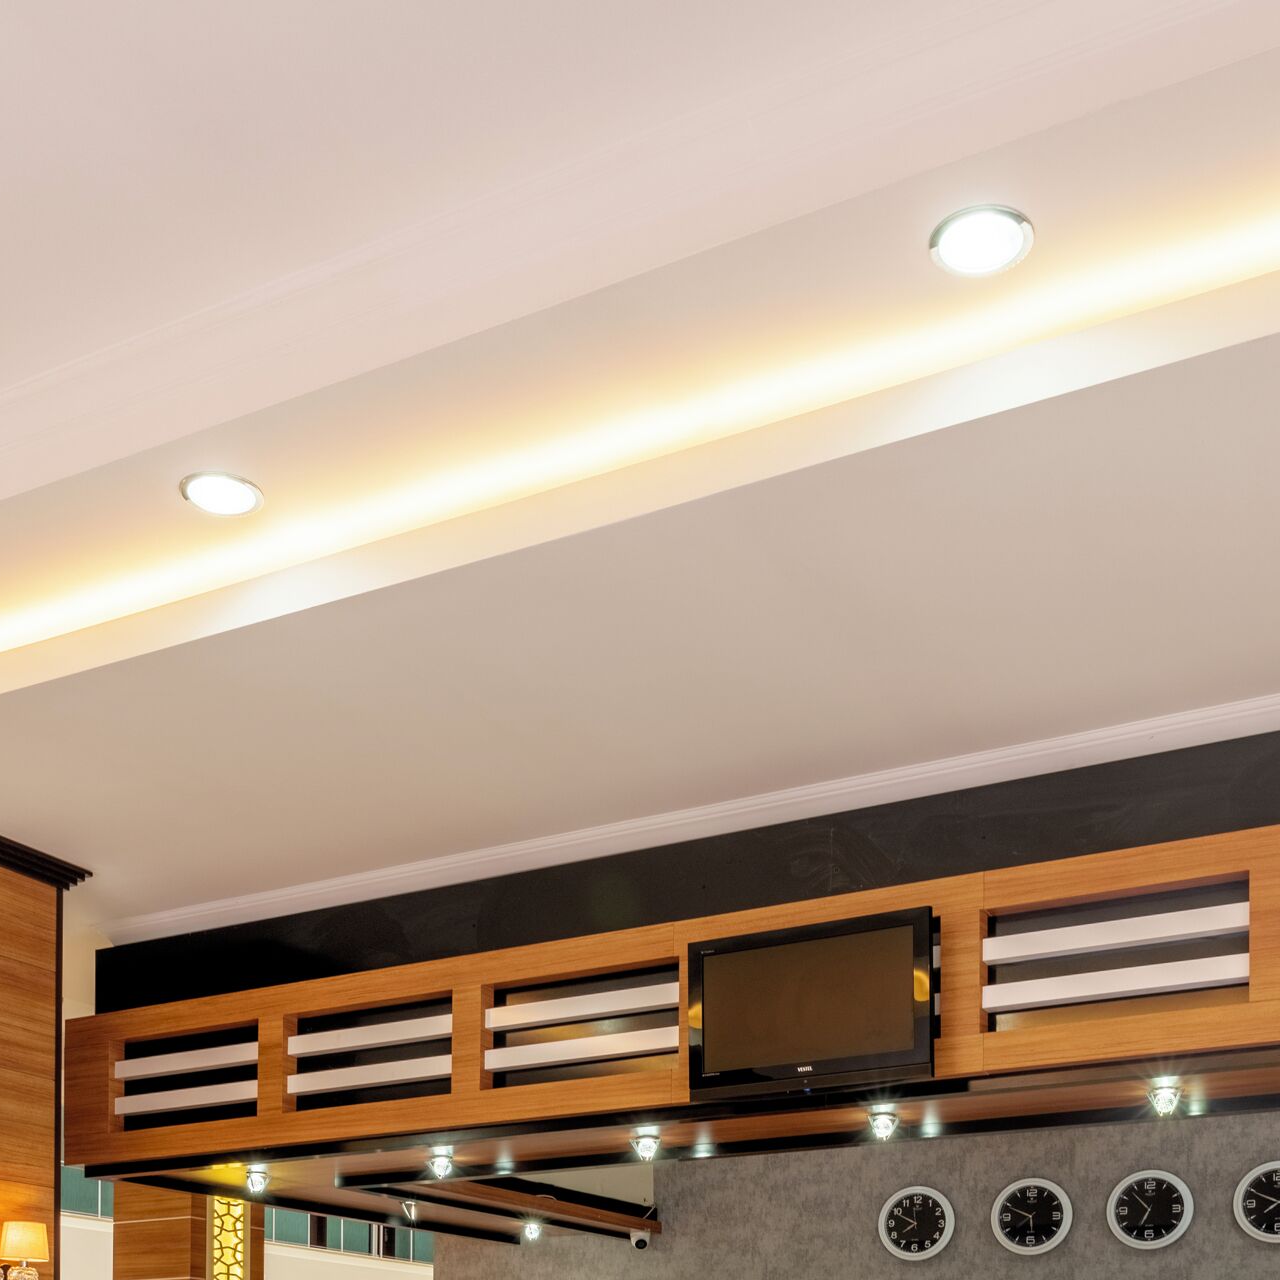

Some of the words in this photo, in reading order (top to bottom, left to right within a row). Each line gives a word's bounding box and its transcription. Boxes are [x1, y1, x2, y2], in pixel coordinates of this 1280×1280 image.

[1144, 1181, 1156, 1190] 12
[1027, 1189, 1038, 1197] 12
[913, 1196, 923, 1204] 12
[1247, 1199, 1256, 1208] 9
[935, 1208, 942, 1216] 2
[1119, 1206, 1128, 1215] 9
[1172, 1204, 1181, 1213] 3
[1003, 1213, 1011, 1222] 9
[1052, 1212, 1061, 1220] 3
[888, 1219, 895, 1227] 9
[938, 1219, 944, 1227] 3
[1145, 1230, 1154, 1238] 6
[900, 1240, 906, 1248] 7
[1026, 1236, 1035, 1245] 6
[911, 1244, 918, 1252] 6
